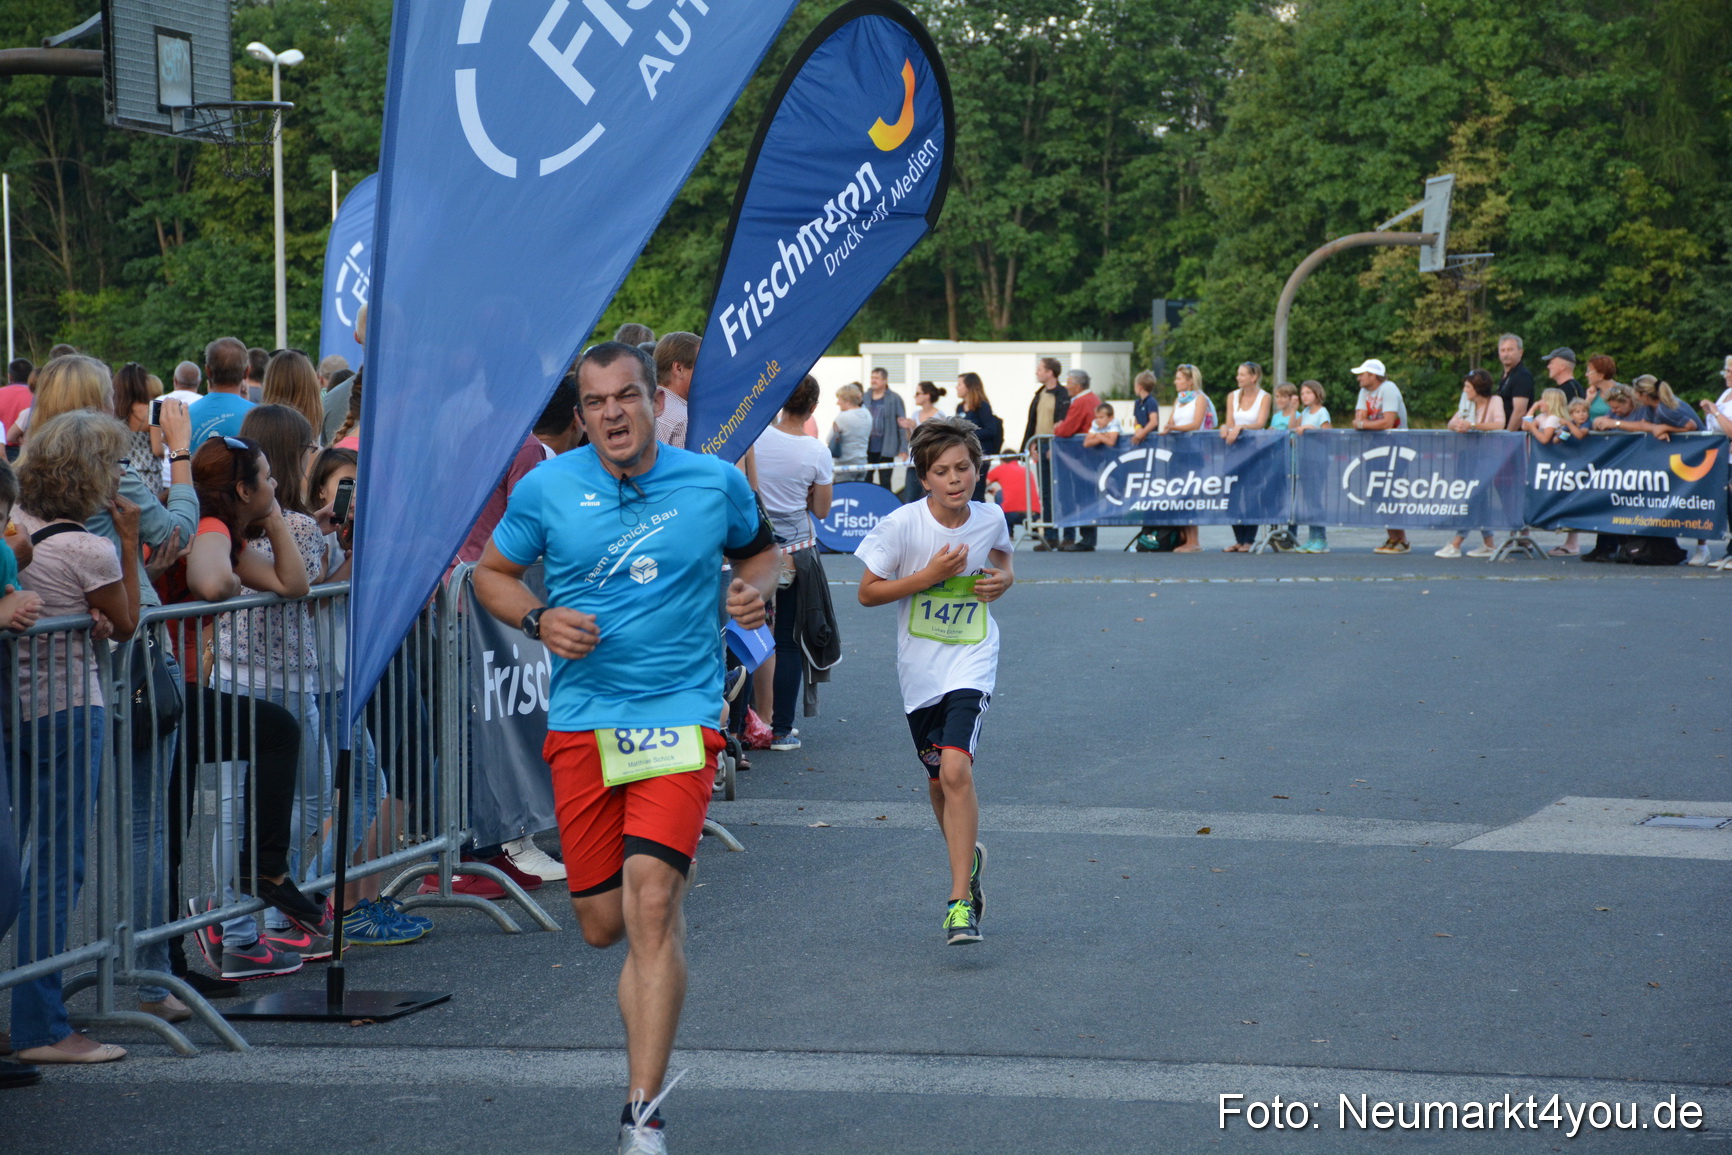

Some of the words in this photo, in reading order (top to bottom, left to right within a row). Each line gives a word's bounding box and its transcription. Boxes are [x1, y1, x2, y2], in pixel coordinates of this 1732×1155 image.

[823, 222, 865, 278] Druck
[890, 137, 939, 207] Medien
[719, 161, 882, 358] Frischmann
[701, 357, 782, 456] frischmann-net.de
[1125, 470, 1239, 499] Fischer
[1365, 470, 1480, 500] Fischer
[1534, 462, 1670, 493] Frischmann
[1129, 498, 1230, 511] AUTOMOBILE
[1375, 502, 1469, 517] AUTOMOBILE
[1611, 492, 1645, 508] Druck
[1647, 494, 1669, 509] und
[1669, 494, 1716, 510] Medien
[607, 522, 650, 555] Schick
[650, 508, 679, 526] Bau
[1612, 514, 1714, 531] www.frischmann-net.de
[920, 599, 979, 625] 1477
[482, 643, 552, 722] Frisc
[614, 727, 680, 755] 825
[652, 755, 675, 763] Schick
